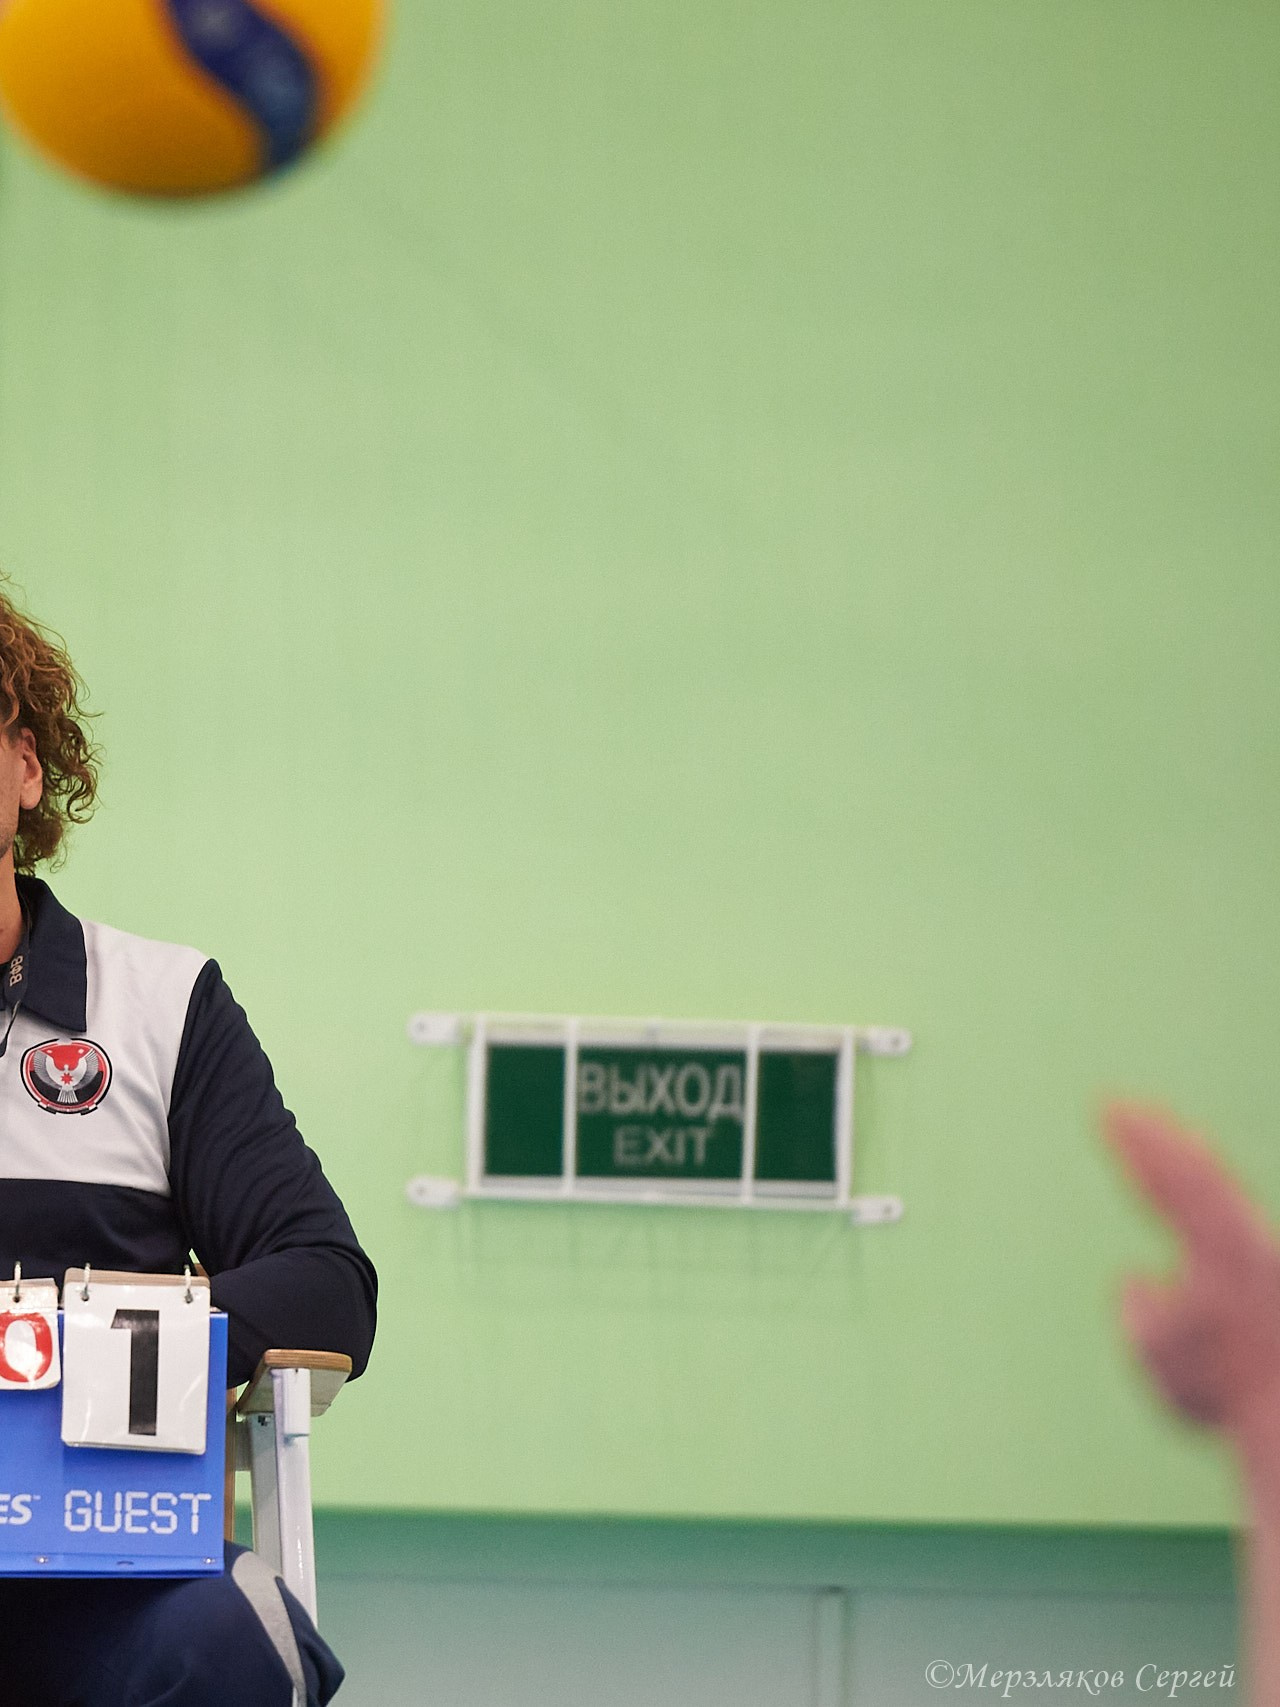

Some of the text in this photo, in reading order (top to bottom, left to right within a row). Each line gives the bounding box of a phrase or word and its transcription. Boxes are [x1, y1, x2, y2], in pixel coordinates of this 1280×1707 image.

[577, 1062, 745, 1122] ВЫХОД
[613, 1125, 715, 1166] EXIT
[110, 1308, 160, 1436] 1
[64, 1489, 212, 1535] GUEST
